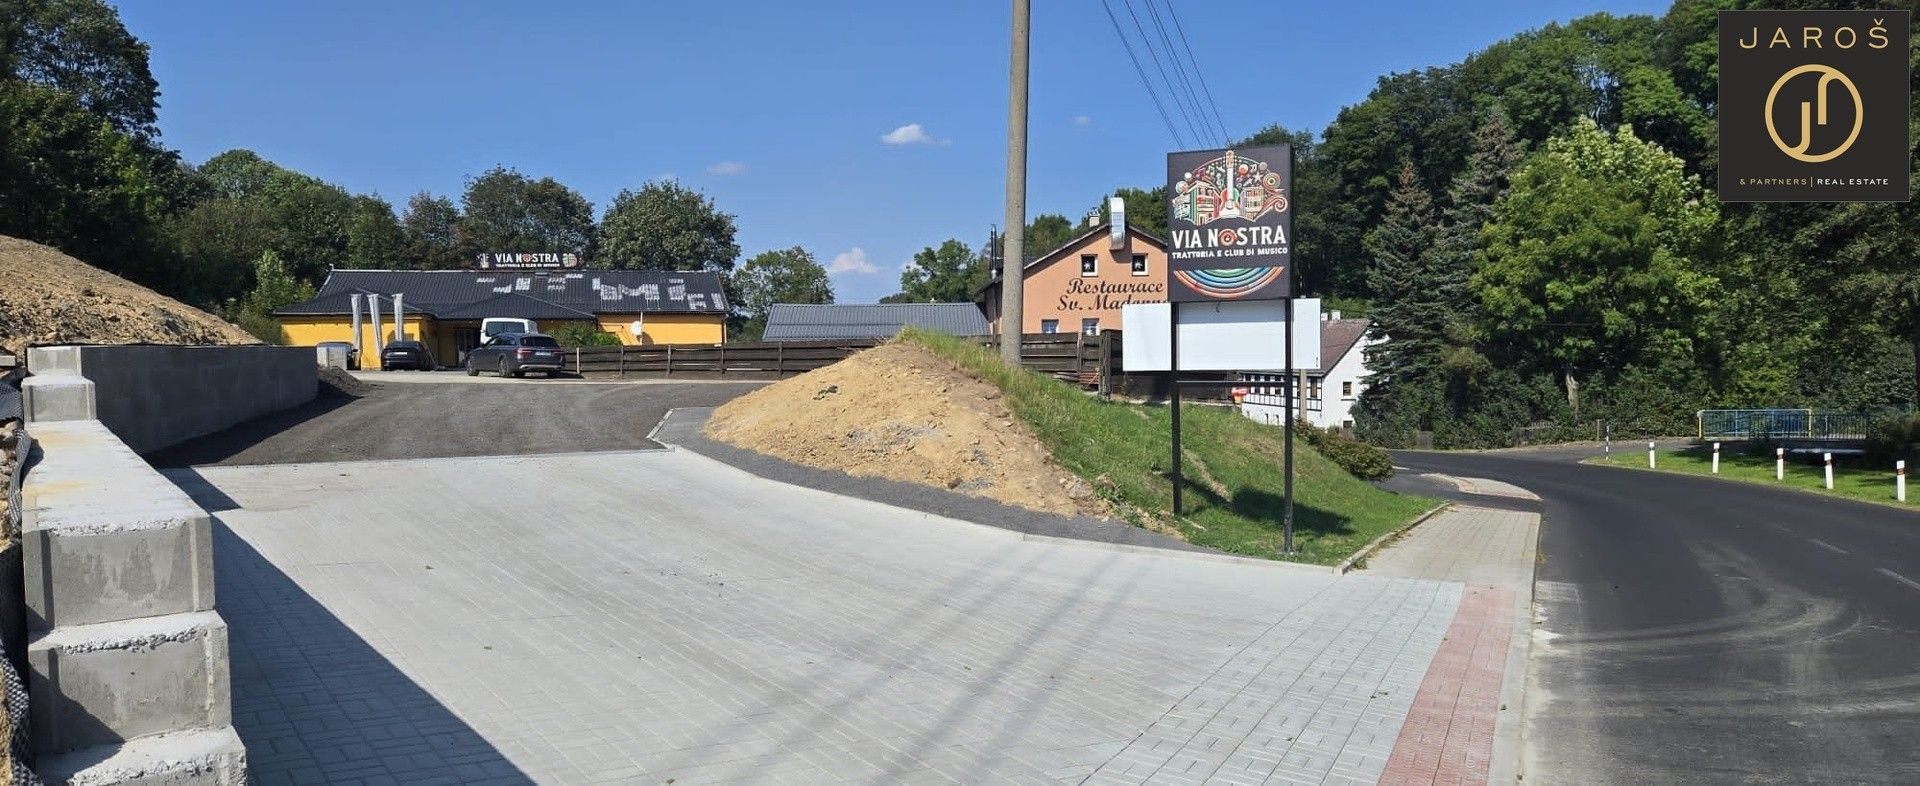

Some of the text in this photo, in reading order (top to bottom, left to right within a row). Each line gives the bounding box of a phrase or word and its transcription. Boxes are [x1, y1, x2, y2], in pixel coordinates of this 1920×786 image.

[1171, 225, 1287, 249] VIA NOSTRA
[495, 252, 559, 263] VIA NOSTRA
[1172, 250, 1215, 259] TRATTORIA
[1224, 249, 1244, 257] CLUB
[1246, 248, 1254, 256] DI
[1257, 247, 1288, 255] MUSICO
[1067, 278, 1163, 294] Restaurace
[1057, 294, 1083, 311] Sv.
